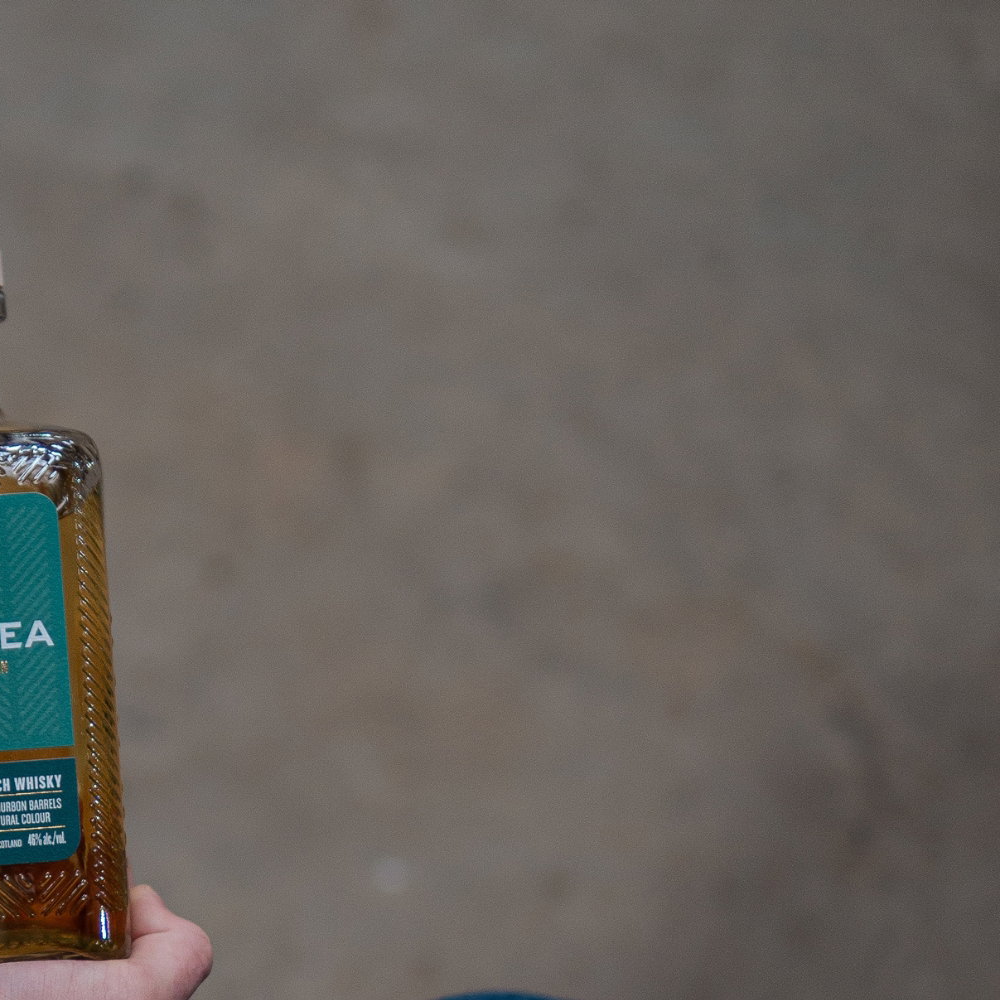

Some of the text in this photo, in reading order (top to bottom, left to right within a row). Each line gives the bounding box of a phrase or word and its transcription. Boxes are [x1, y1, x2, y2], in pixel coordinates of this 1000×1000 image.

[14, 775, 61, 790] WHISKY
[29, 798, 61, 810] BARRELS
[21, 812, 50, 824] COLOUR
[28, 833, 42, 846] 46%
[43, 831, 66, 845] alc./vol.
